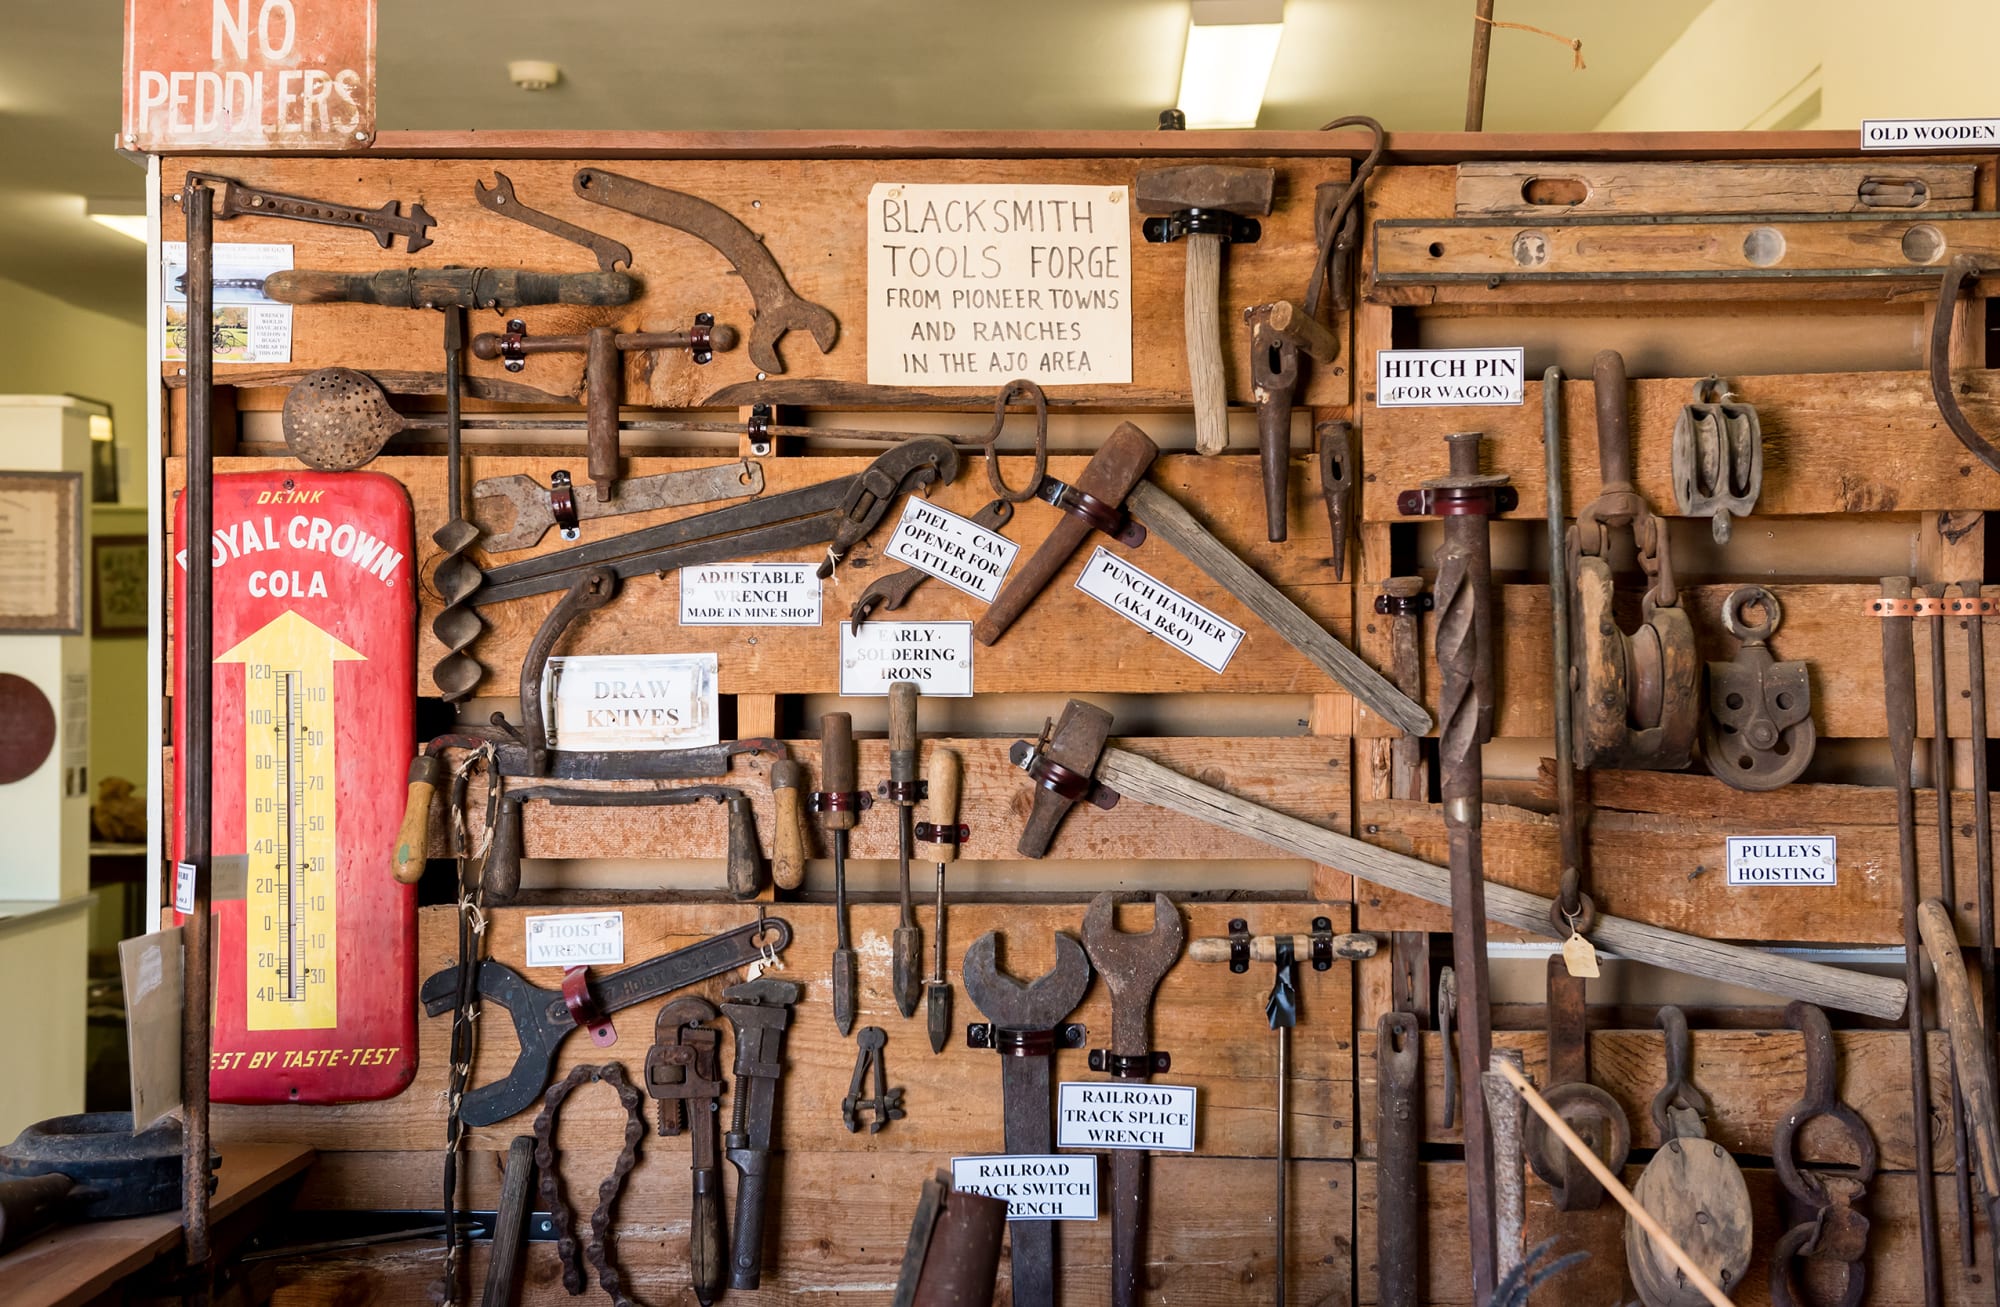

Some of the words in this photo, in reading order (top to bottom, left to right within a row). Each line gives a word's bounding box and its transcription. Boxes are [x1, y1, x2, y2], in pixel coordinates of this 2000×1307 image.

[211, 0, 295, 60] NO
[139, 69, 360, 134] PEDDLERS
[1870, 127, 1908, 141] OLD
[1914, 125, 1996, 139] WOODEN
[883, 199, 1093, 233] BLACKSMITH
[883, 245, 1001, 278] TOOLS
[1031, 246, 1119, 279] FORGE
[887, 288, 941, 309] FROM
[953, 289, 1043, 310] PIONEER
[1049, 289, 1119, 309] TOWNS
[911, 322, 955, 341] AND
[973, 322, 1081, 341] RANCHES
[903, 353, 928, 373] IN
[939, 353, 978, 373] THE
[989, 352, 1028, 372] AJO
[1039, 351, 1091, 372] AREA
[1384, 359, 1466, 378] HITCH
[1475, 358, 1516, 377] PIN
[1391, 386, 1432, 400] (FOR
[1437, 385, 1509, 400] WAGON)
[257, 490, 325, 504] DRINK
[916, 508, 949, 532] PIEL
[973, 535, 1006, 558] CAN
[288, 516, 404, 582] CROWN
[904, 524, 966, 561] OPENER
[968, 553, 1000, 577] FOR
[900, 542, 986, 592] CATTLEOIL
[248, 570, 328, 598] COLA
[697, 571, 805, 584] ADJUSTABLE
[713, 590, 788, 603] WRENCH
[1102, 561, 1156, 600] PUNCH
[1155, 593, 1226, 643] HAMMER
[687, 607, 724, 618] MADE
[728, 607, 741, 618] IN
[745, 607, 778, 618] MINE
[780, 607, 815, 618] SHOP
[1114, 592, 1151, 621] (AKA
[1154, 615, 1194, 647] B&O)
[879, 629, 935, 642] EARLY
[857, 648, 955, 661] SOLDERING
[250, 665, 271, 679] 120
[881, 667, 932, 680] IRONS
[307, 687, 325, 701] 110
[594, 680, 671, 699] DRAW
[250, 709, 271, 724] 100
[586, 708, 680, 727] KNIVES
[308, 731, 323, 746] 90
[256, 754, 271, 769] 80
[308, 776, 324, 790] 70
[256, 798, 271, 812] 60
[309, 816, 324, 831] 50
[254, 839, 272, 854] 40
[1742, 845, 1821, 858] PULLEYS
[309, 857, 324, 872] 30
[1738, 867, 1825, 880] HOISTING
[256, 879, 272, 893] 20
[310, 896, 324, 911] 10
[264, 916, 271, 931] 0
[549, 924, 601, 938] HOIST
[310, 933, 325, 948] 10
[537, 942, 613, 958] WRENCH
[259, 953, 274, 968] 20
[310, 969, 325, 984] 30
[256, 986, 274, 1001] 40
[248, 1051, 278, 1069] BY
[282, 1047, 400, 1068] TASTE-TEST
[1082, 1090, 1173, 1105] RAILROAD
[1064, 1109, 1125, 1123] TRACK
[1128, 1111, 1189, 1126] SPLICE
[1088, 1129, 1164, 1144] WRENCH
[980, 1163, 1070, 1177] RAILROAD
[1023, 1183, 1090, 1196] SWITCH
[1007, 1202, 1063, 1215] RENCH
